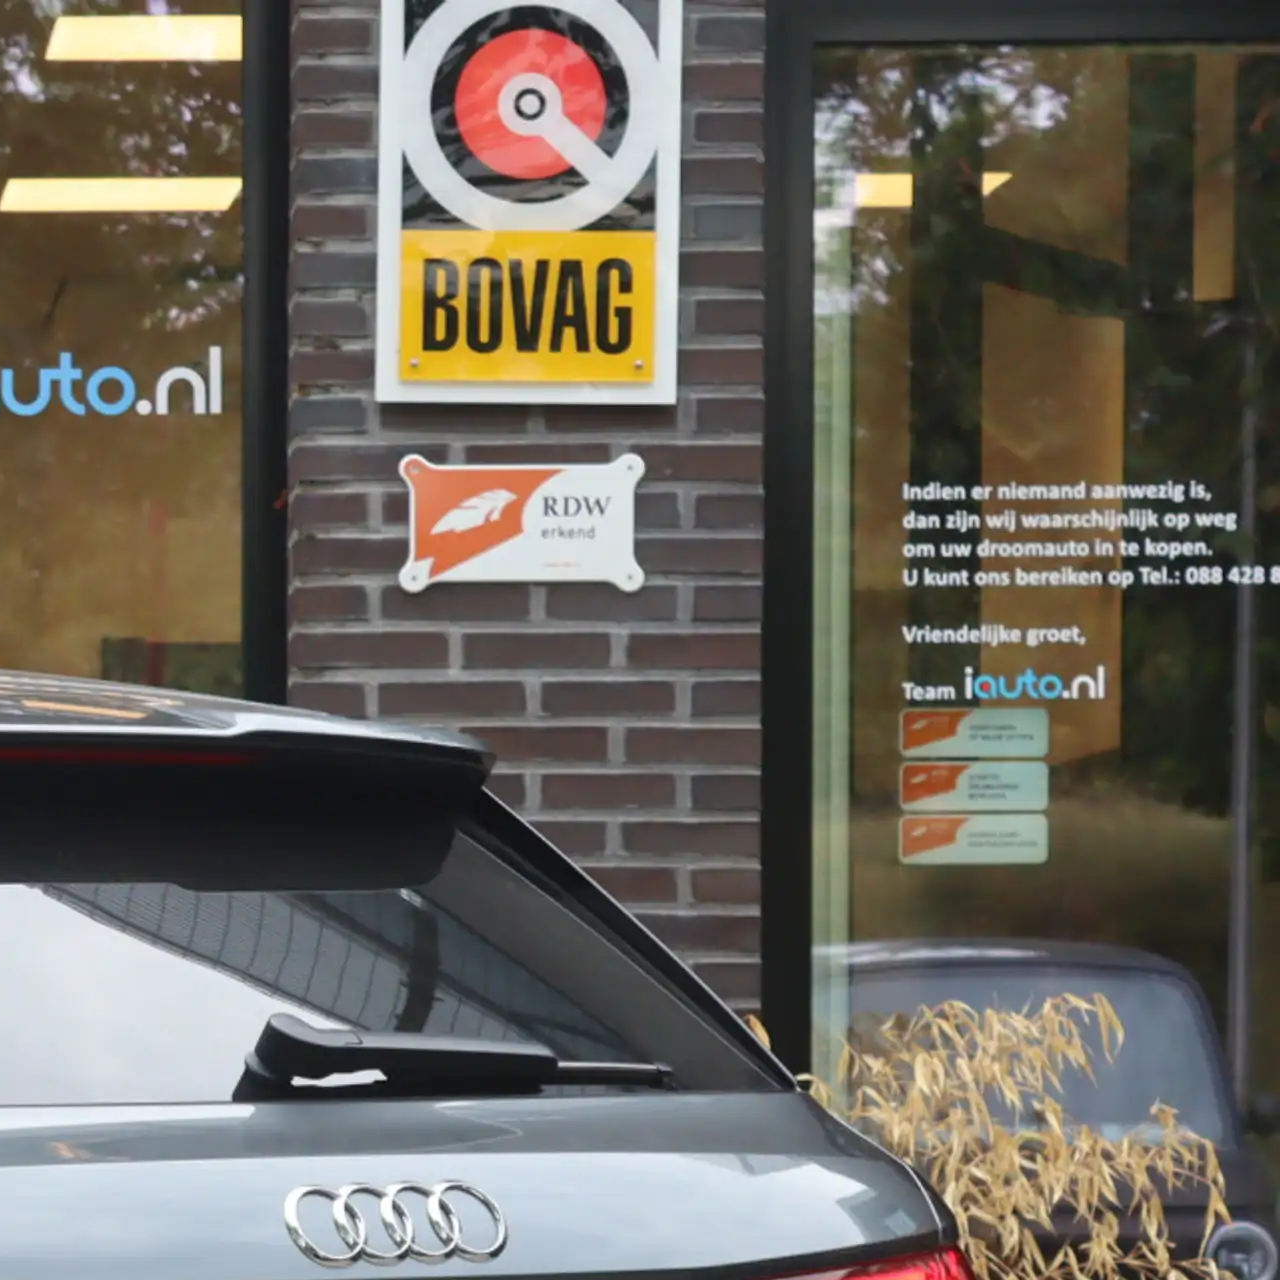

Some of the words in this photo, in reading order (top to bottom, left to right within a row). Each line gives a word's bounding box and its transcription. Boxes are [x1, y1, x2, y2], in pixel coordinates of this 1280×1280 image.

[421, 257, 634, 355] BOVAG
[902, 482, 966, 500] Indien
[971, 485, 993, 500] er
[997, 481, 1086, 500] niemand
[1091, 480, 1185, 503] aanwezig
[1189, 480, 1212, 501] is,
[542, 495, 612, 517] RDW
[540, 524, 596, 540] erkend
[902, 510, 940, 529] dan
[945, 510, 981, 533] zijn
[985, 510, 1017, 533] wij
[1021, 509, 1159, 532] waarschijnlijk
[1163, 512, 1190, 532] op
[1194, 512, 1238, 532] weg
[902, 542, 935, 558] om
[940, 542, 972, 558] uw
[976, 538, 1090, 558] droomauto
[1094, 538, 1114, 556] in
[1119, 541, 1140, 556] te
[1144, 537, 1213, 560] kopen.
[902, 568, 918, 587] U
[923, 567, 969, 587] kunt
[974, 571, 1011, 587] ons
[1015, 566, 1103, 587] bereiken
[1107, 569, 1134, 589] op
[1139, 566, 1180, 585] Tel.:
[1184, 565, 1223, 585] 088
[1227, 565, 1266, 585] 428
[901, 625, 1021, 647] Vriendelijke
[1026, 626, 1086, 647] groet,
[901, 682, 956, 701] Team
[964, 665, 1106, 700] iauto.nl
